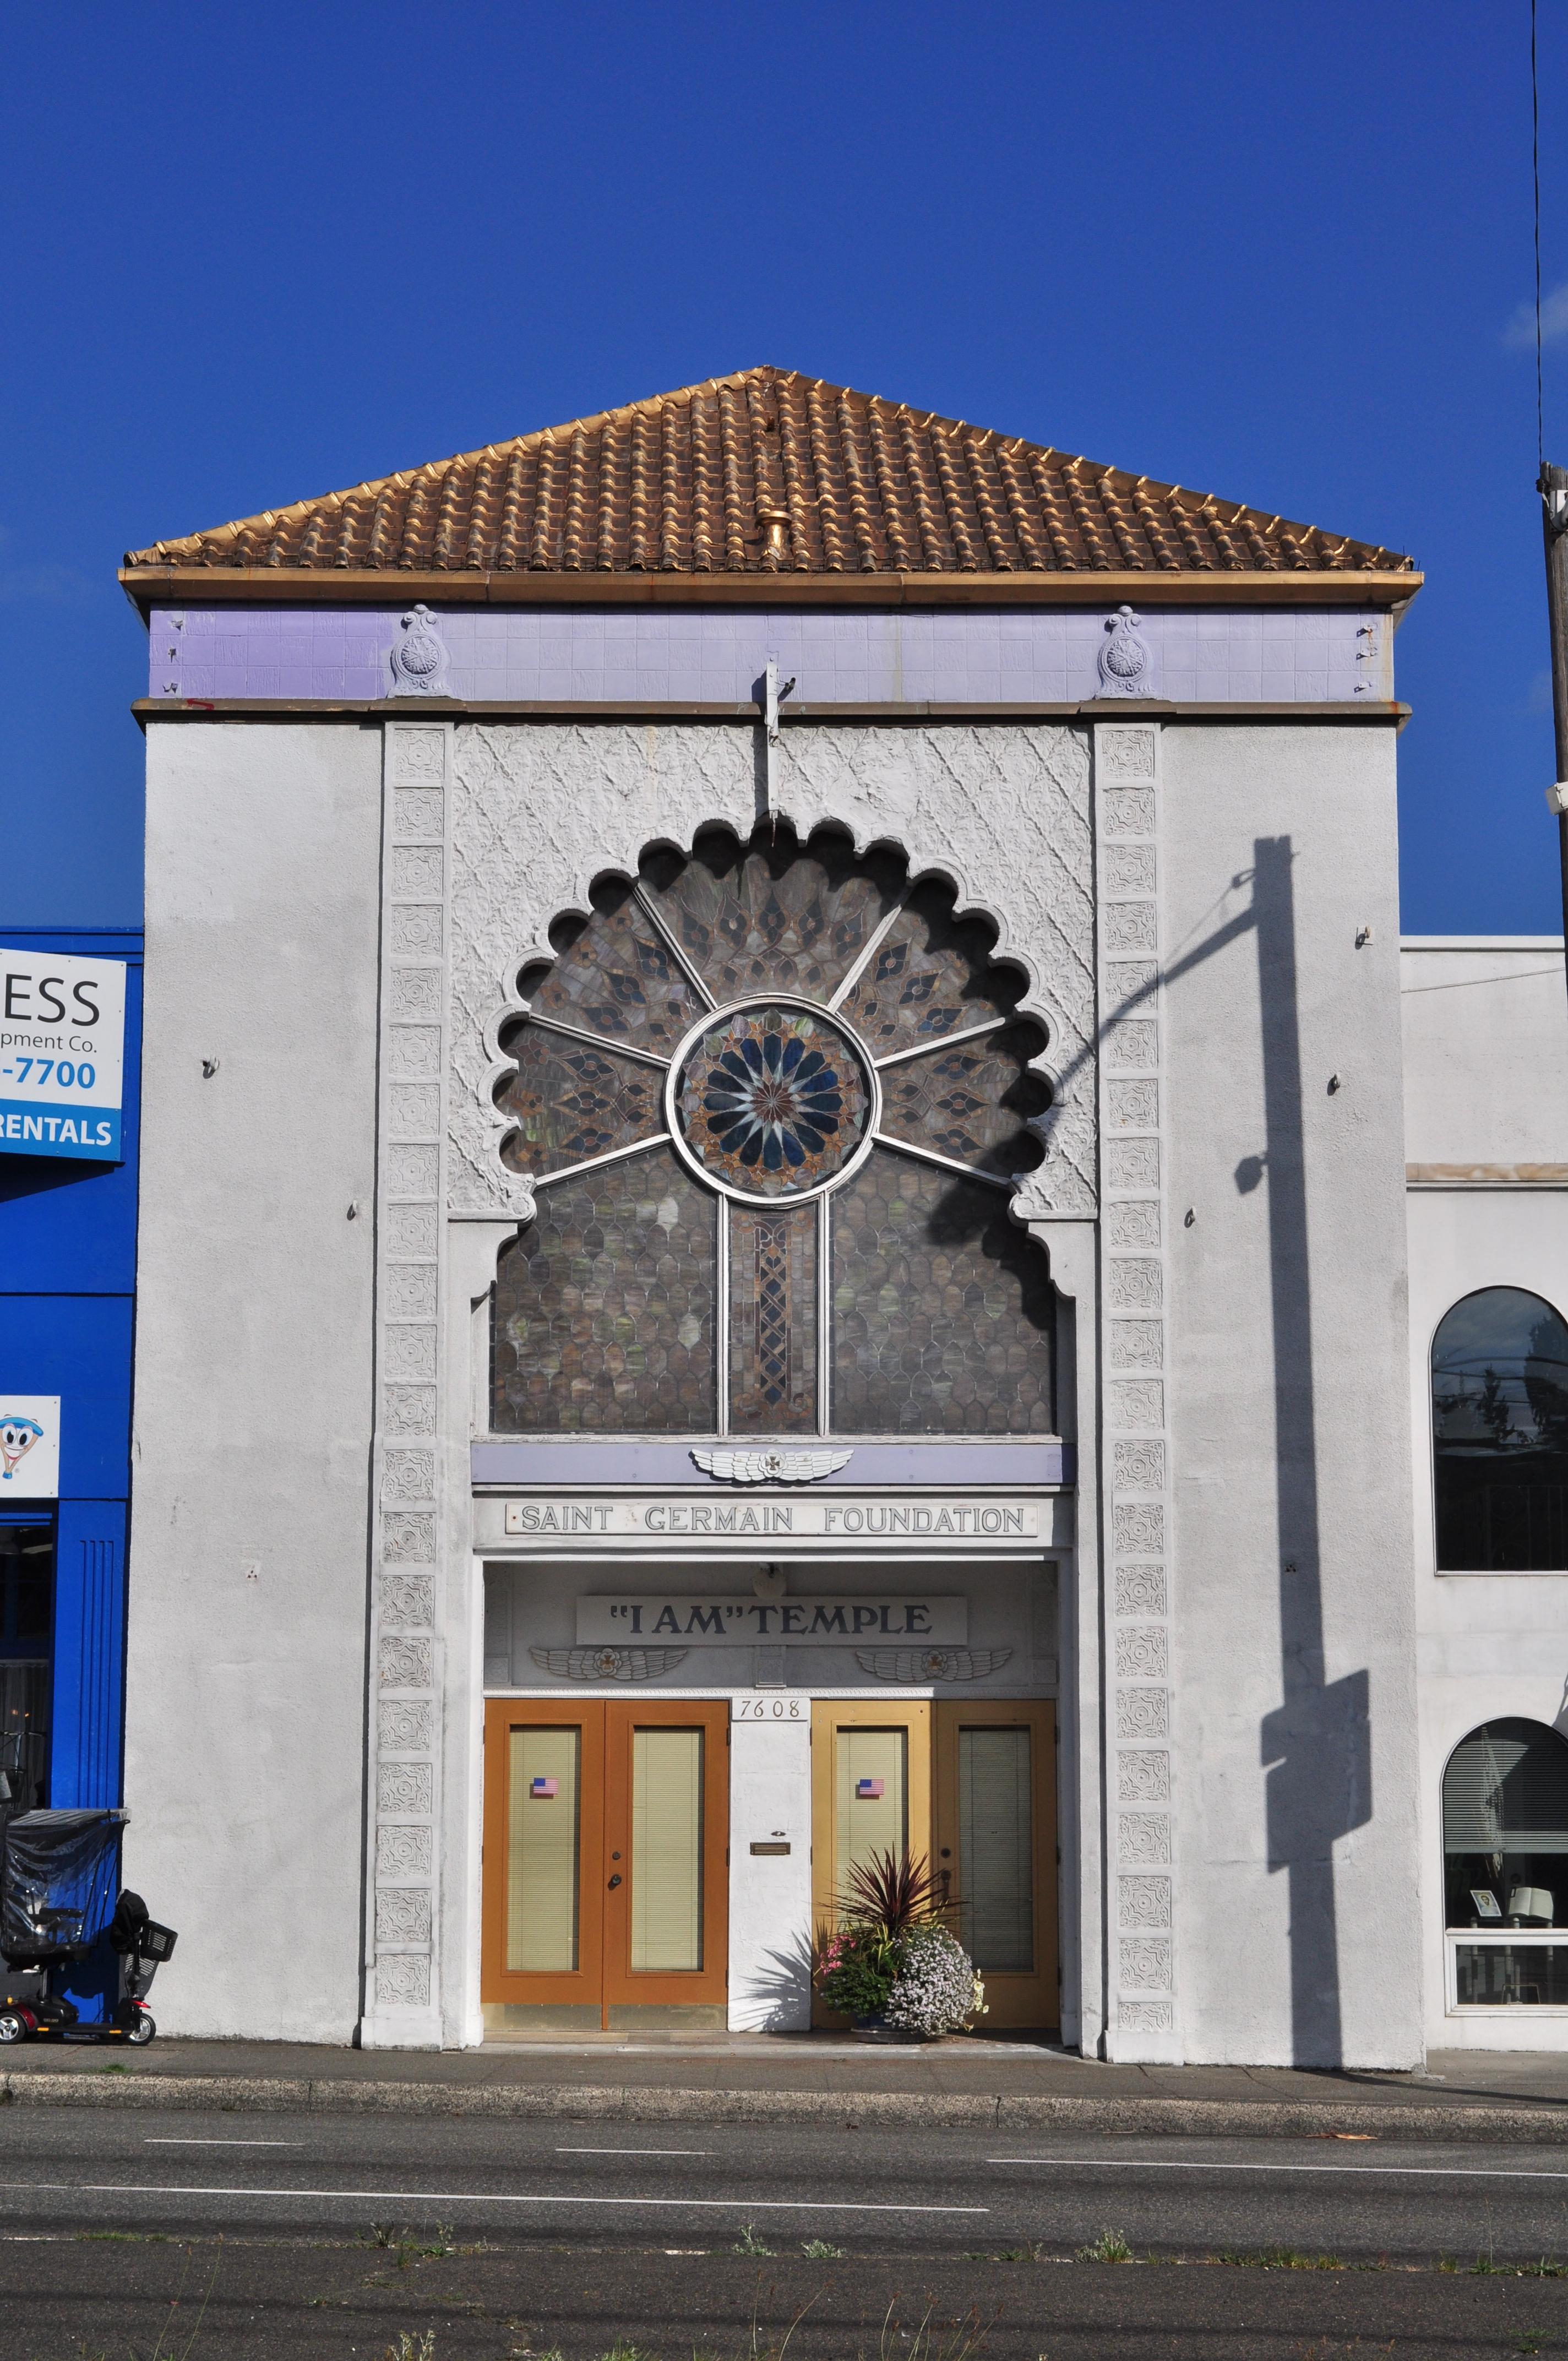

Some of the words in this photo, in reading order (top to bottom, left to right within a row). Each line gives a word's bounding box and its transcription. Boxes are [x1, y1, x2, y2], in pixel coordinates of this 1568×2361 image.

[4, 973, 100, 1026] ESS
[1, 1032, 63, 1049] pment
[69, 1036, 97, 1053] Co.
[3, 1057, 95, 1089] -7700
[522, 1506, 613, 1530] SAINT
[645, 1506, 792, 1531] GERMAIN
[824, 1508, 1024, 1532] FOUNDATION
[748, 1604, 933, 1635] TEMPLE
[741, 1700, 799, 1717] 7608
